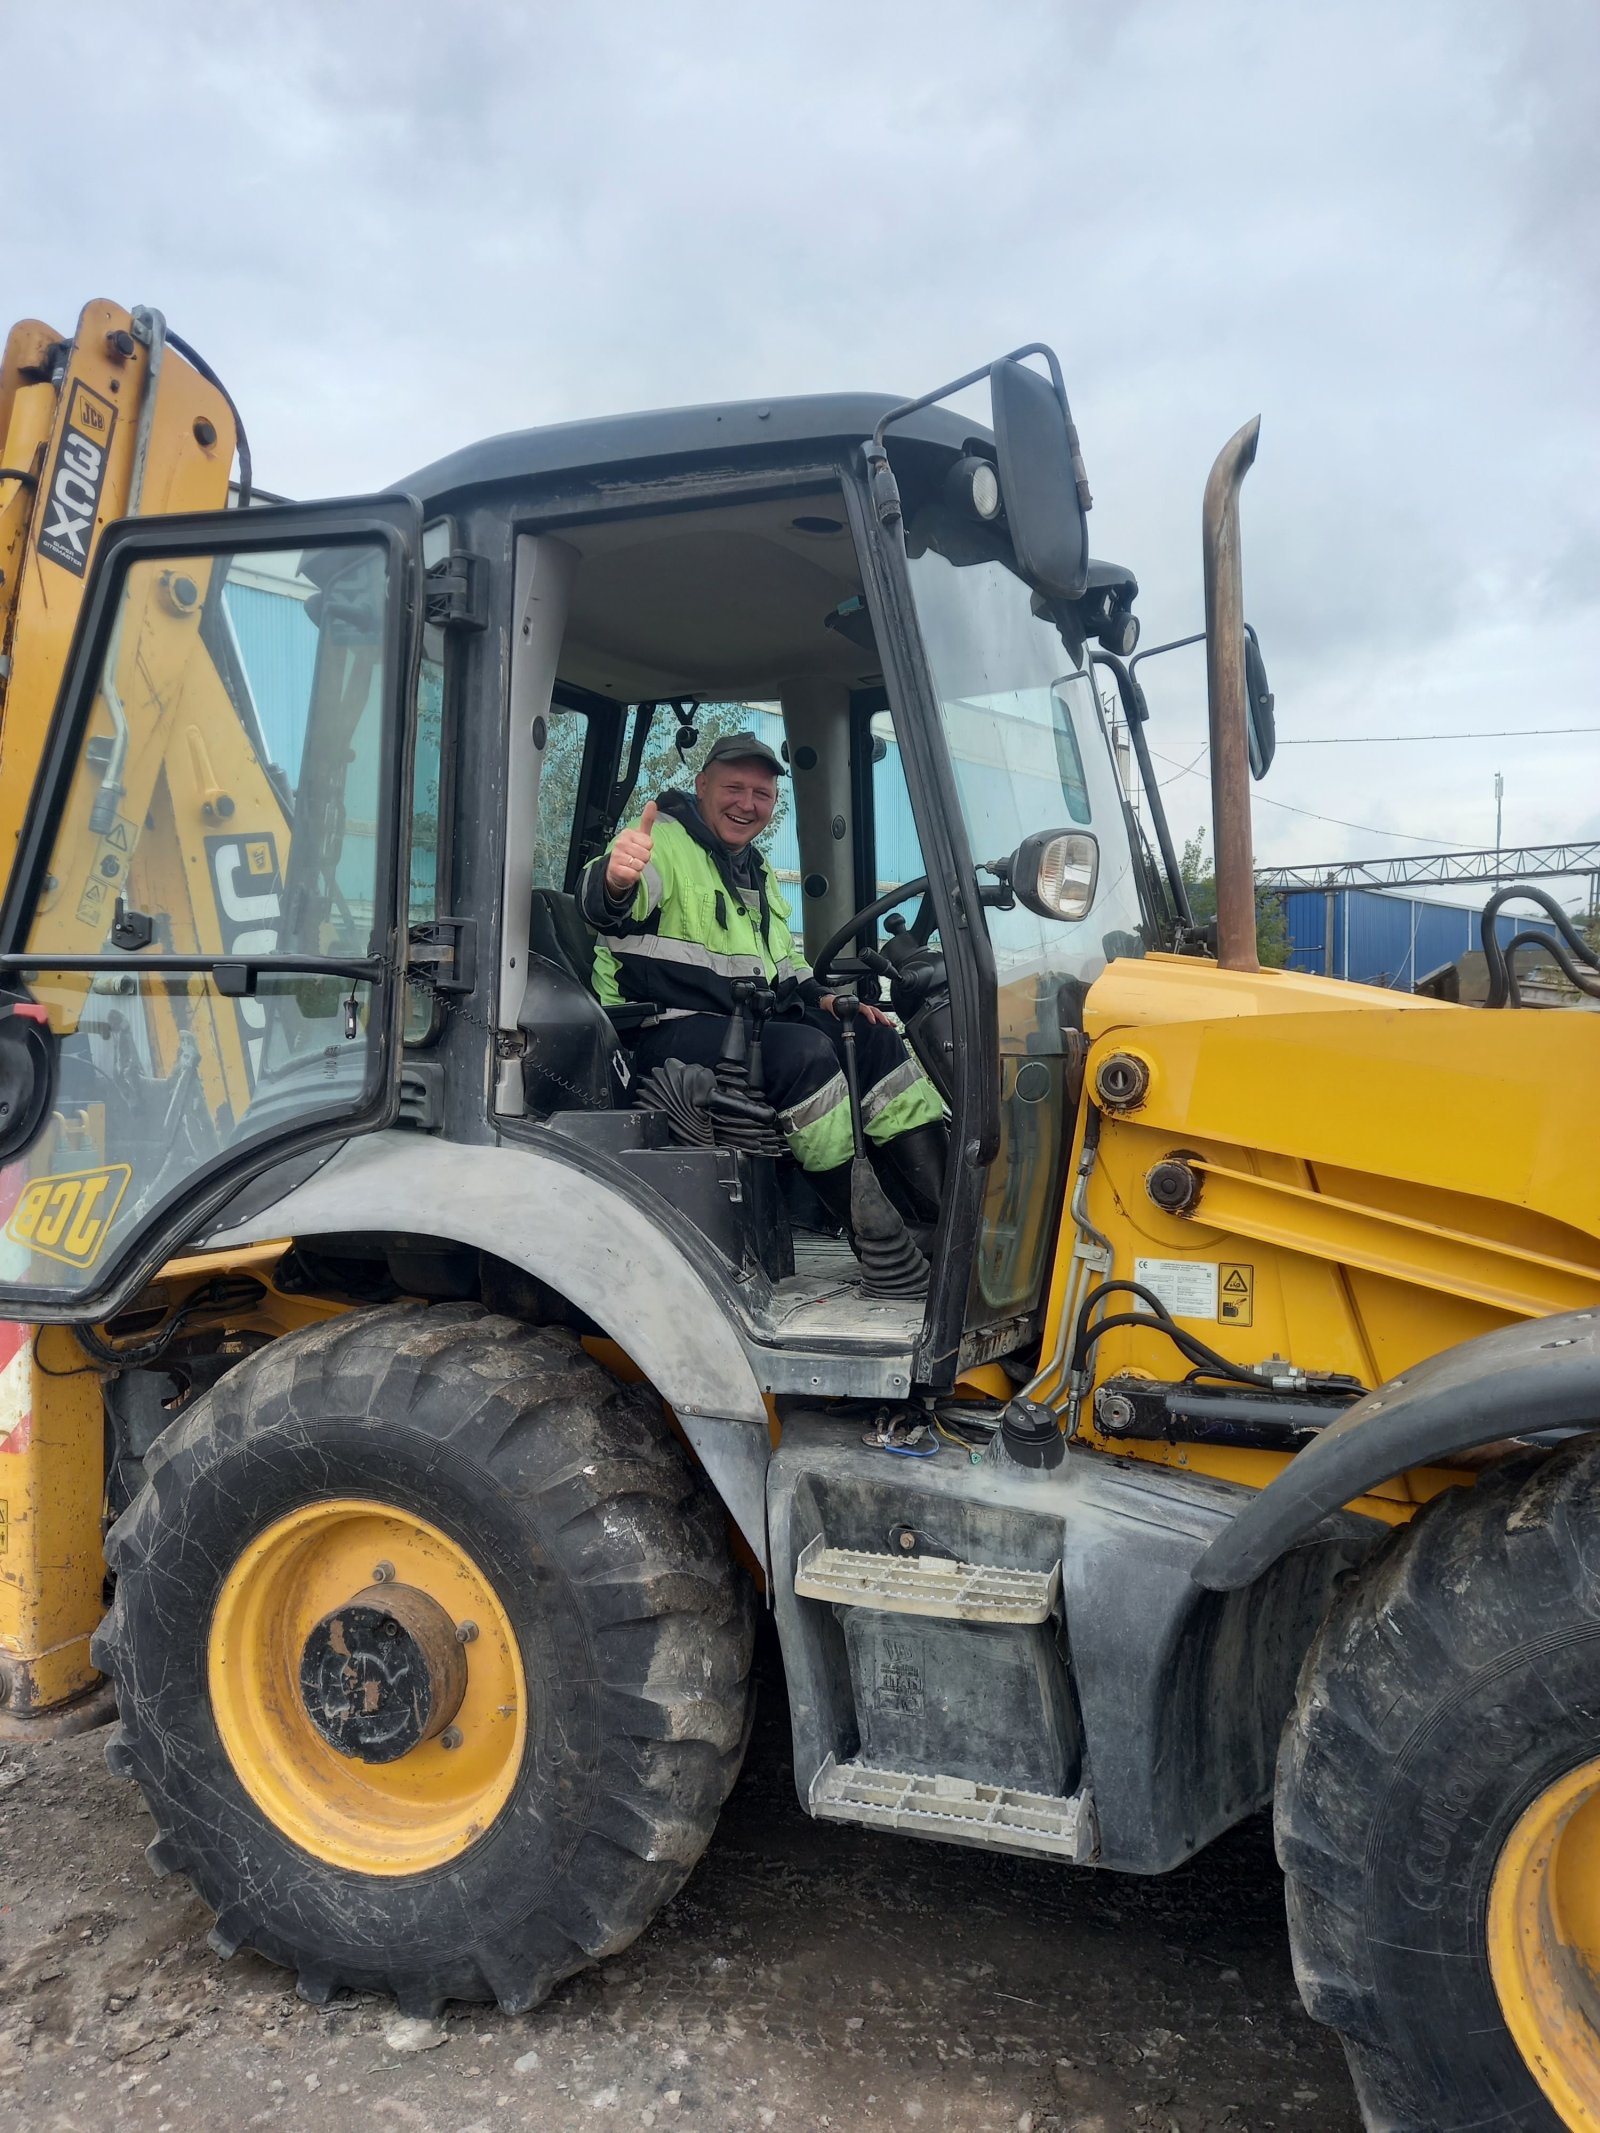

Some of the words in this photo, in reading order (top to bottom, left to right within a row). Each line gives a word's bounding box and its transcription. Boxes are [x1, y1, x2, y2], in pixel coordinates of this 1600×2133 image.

[83, 401, 105, 430] JCB
[43, 432, 102, 556] 3CX
[43, 539, 82, 567] SITEMASTER
[53, 540, 75, 556] SUPER
